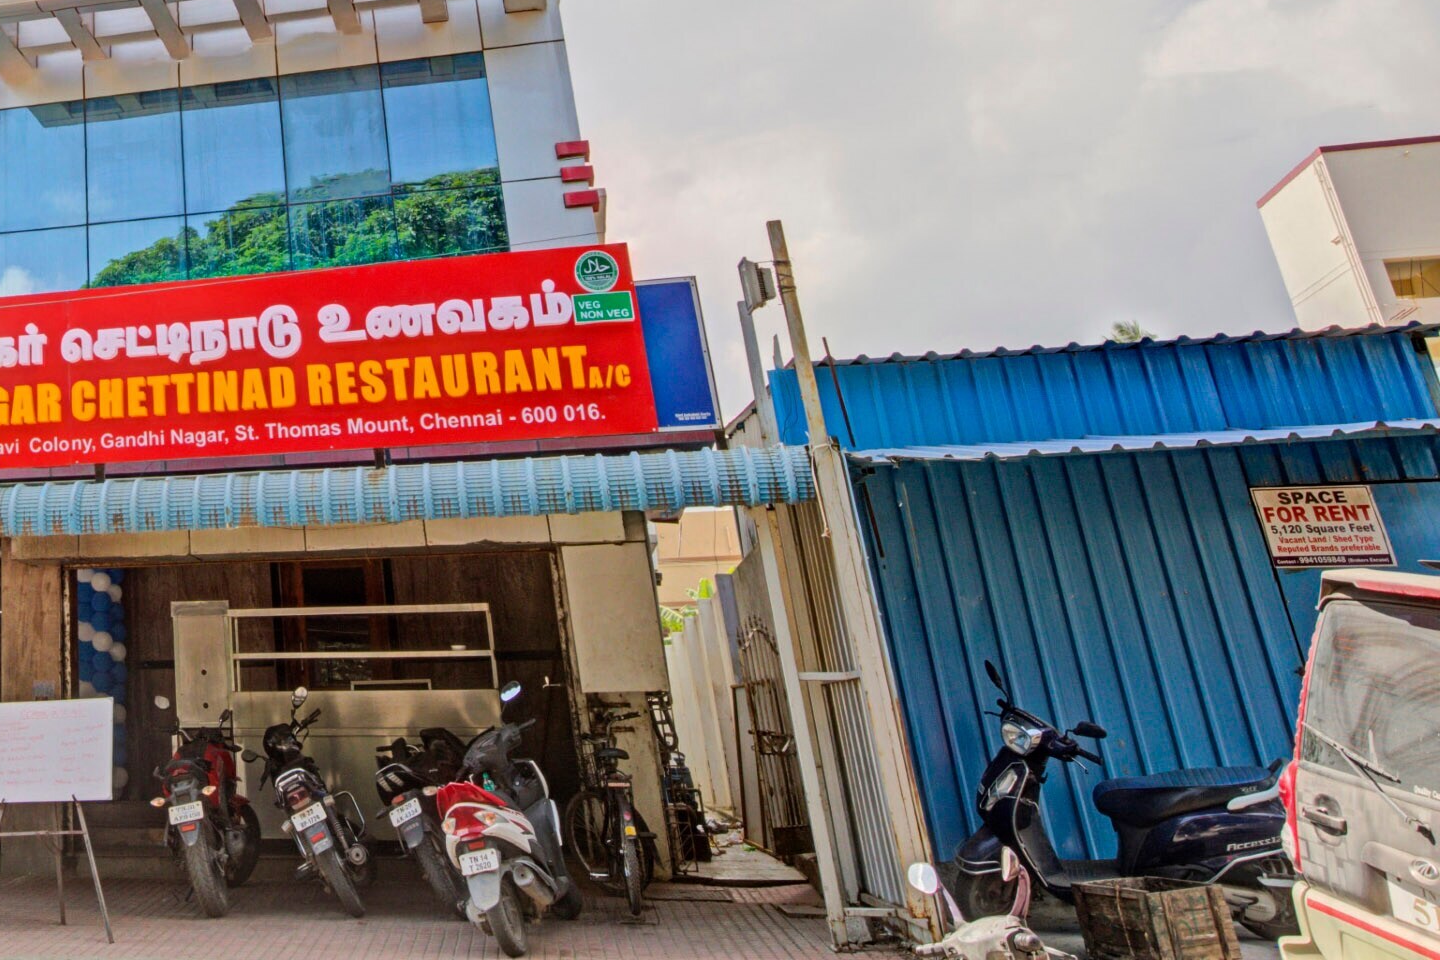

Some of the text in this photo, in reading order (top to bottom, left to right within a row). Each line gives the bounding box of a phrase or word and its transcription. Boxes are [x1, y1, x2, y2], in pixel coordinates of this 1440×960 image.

[578, 300, 601, 310] VEG
[580, 308, 630, 319] NON VEG
[60, 304, 302, 365] செட்டிநாடு
[318, 279, 573, 342] உணவகம்
[70, 365, 297, 423] CHETTINAD
[308, 345, 588, 407] RESTAURANT
[589, 364, 631, 389] A/C
[29, 433, 97, 459] Colony,
[100, 429, 166, 451] Gandhi
[170, 427, 230, 448] Nagar,
[235, 421, 260, 442] St.
[264, 416, 342, 440] Thomas
[346, 412, 416, 435] Mount,
[419, 407, 504, 430] Chennai
[521, 406, 558, 424] 600
[563, 403, 606, 422] 016.
[1277, 491, 1348, 504] SPACE
[1263, 505, 1371, 523] FOR RENT
[1271, 523, 1375, 536] 5,120 Square Feet
[1279, 536, 1305, 544] Vacant
[1354, 534, 1373, 543] Type
[1277, 543, 1381, 553] Reputed Brands preferable
